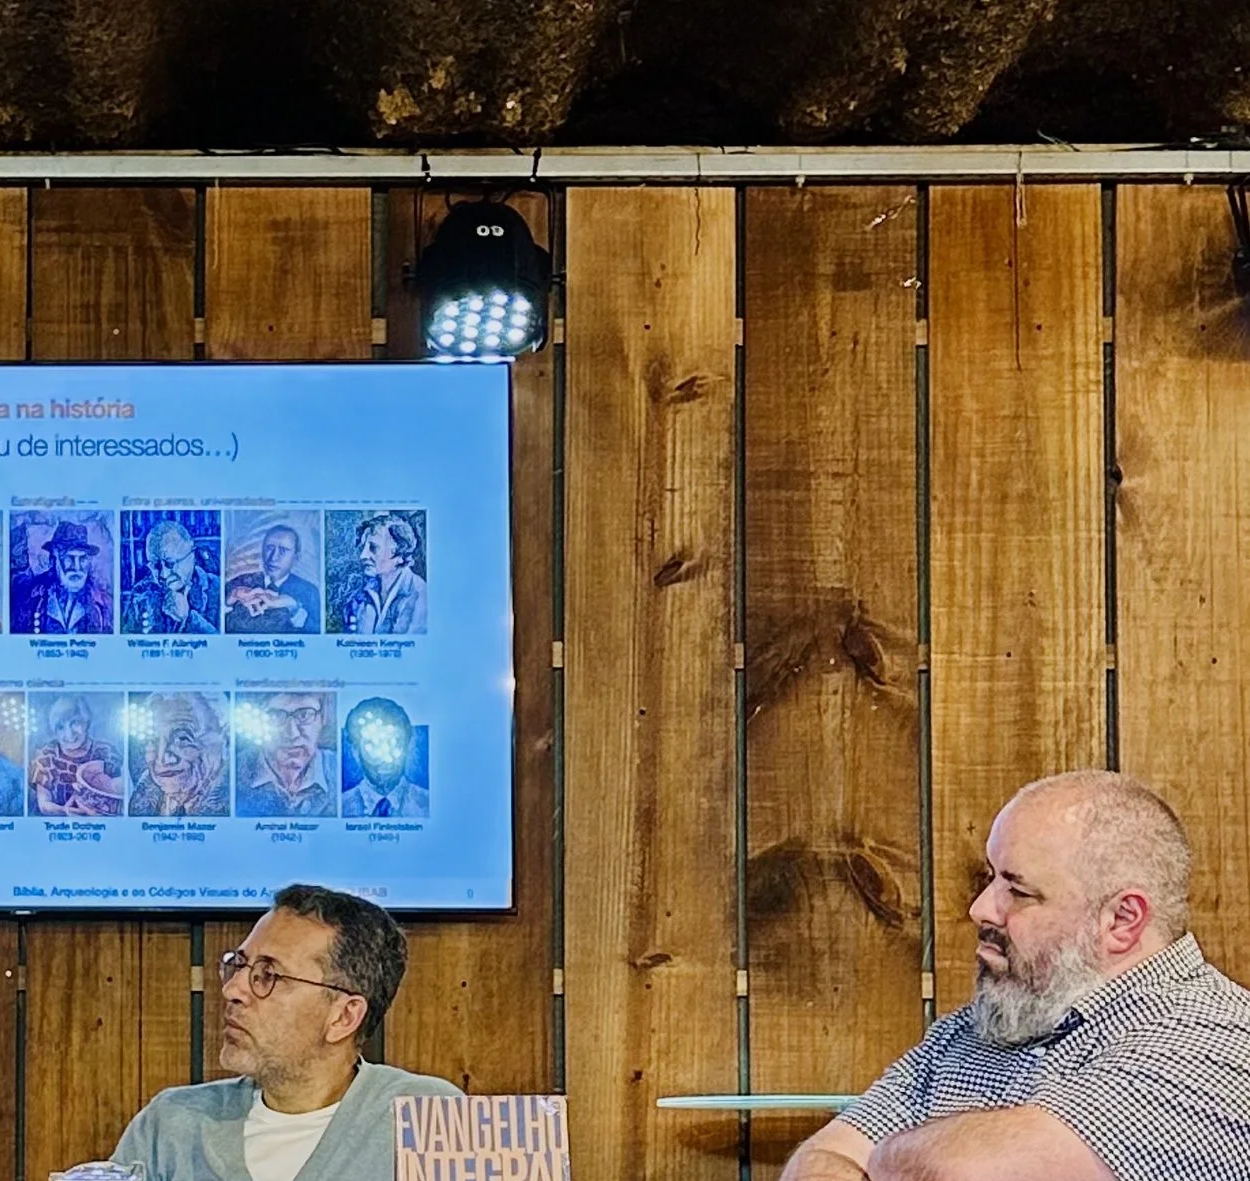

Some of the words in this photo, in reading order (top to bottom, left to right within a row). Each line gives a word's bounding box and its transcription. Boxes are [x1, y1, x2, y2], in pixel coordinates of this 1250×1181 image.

[16, 403, 45, 420] na
[49, 397, 136, 420] história
[16, 434, 49, 457] de
[13, 886, 47, 899] Bíblia,
[51, 886, 119, 900] Arqueologia
[148, 885, 196, 900] Códigos
[396, 1096, 568, 1152] EVANGELHO
